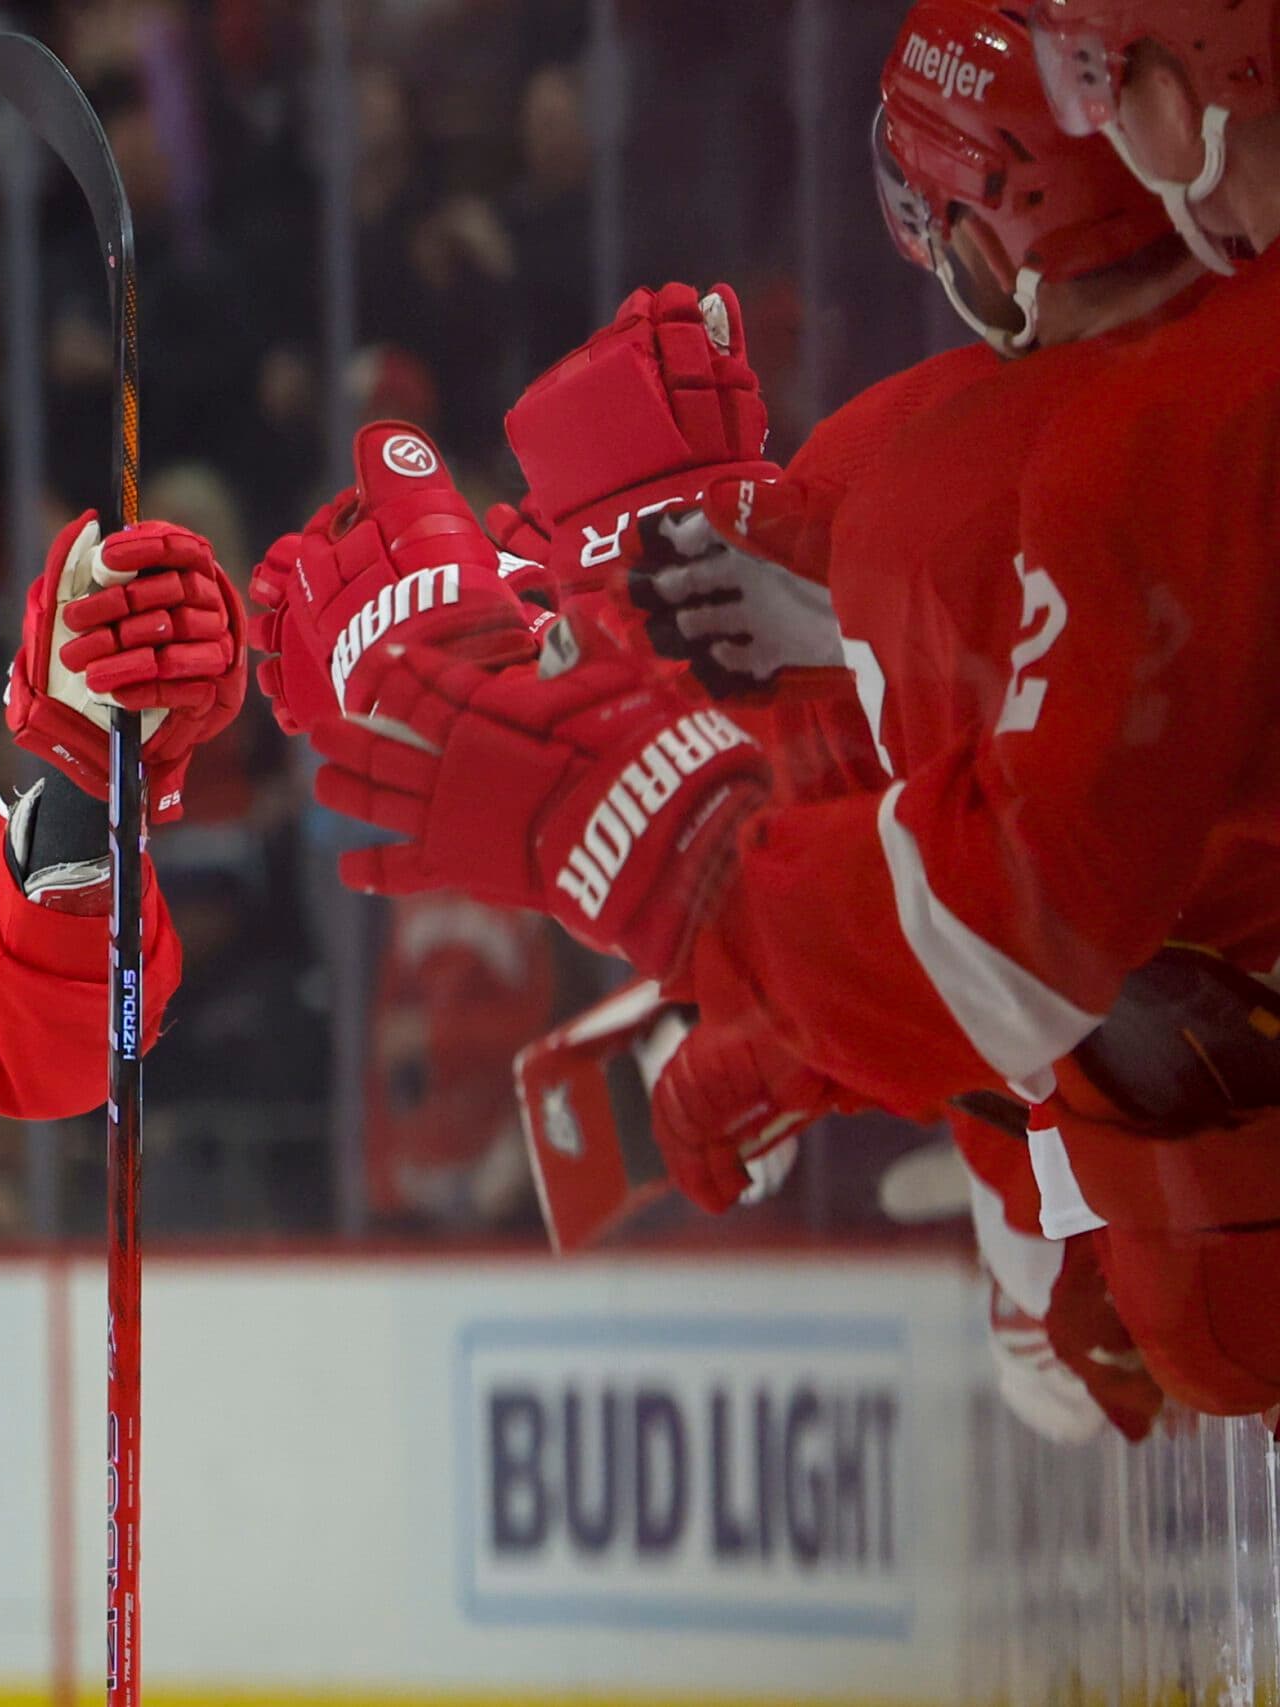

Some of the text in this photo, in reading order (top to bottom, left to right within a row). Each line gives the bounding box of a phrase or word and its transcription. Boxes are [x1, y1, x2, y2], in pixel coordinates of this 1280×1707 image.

[903, 32, 995, 101] meijer
[556, 708, 758, 921] ARRIOR
[122, 968, 137, 1061] HZRDUS
[487, 1378, 898, 1570] BUD LIGHT
